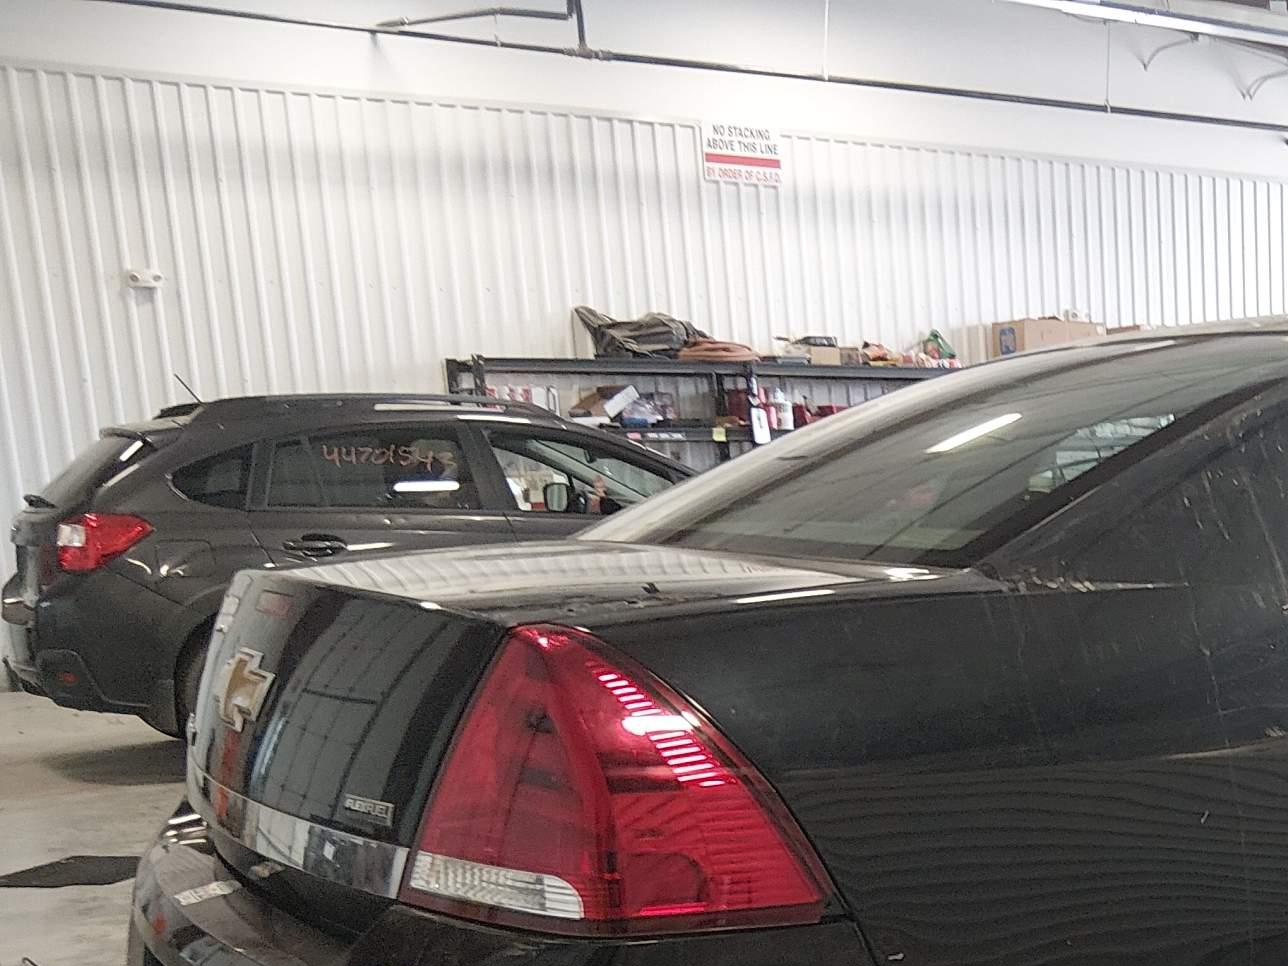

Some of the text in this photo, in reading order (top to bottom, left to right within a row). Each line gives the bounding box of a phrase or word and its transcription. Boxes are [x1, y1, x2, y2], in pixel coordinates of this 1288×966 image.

[712, 124, 771, 141] NO STACKING
[706, 138, 779, 155] ABOVE THIS LINE
